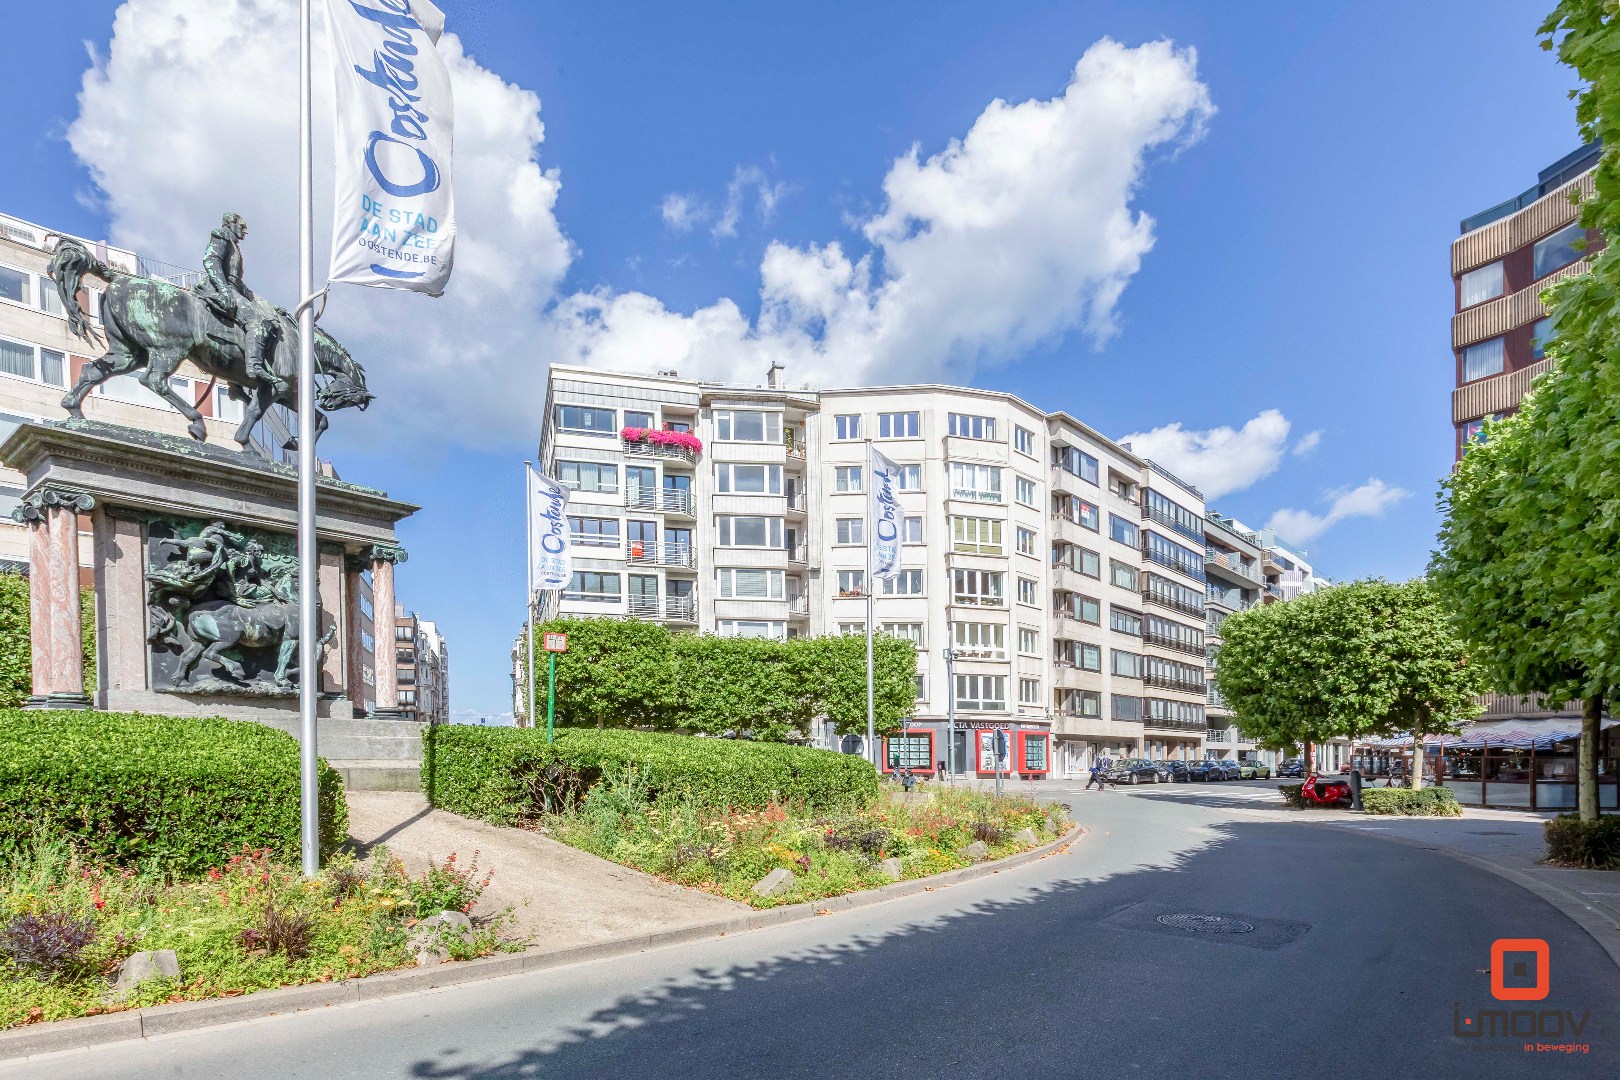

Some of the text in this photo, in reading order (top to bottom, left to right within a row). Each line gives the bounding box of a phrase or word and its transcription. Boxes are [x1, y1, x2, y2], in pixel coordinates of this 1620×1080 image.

[361, 193, 438, 233] DE STAD
[360, 217, 436, 249] AAN ZEE
[358, 237, 437, 266] OOSTENDE.BE
